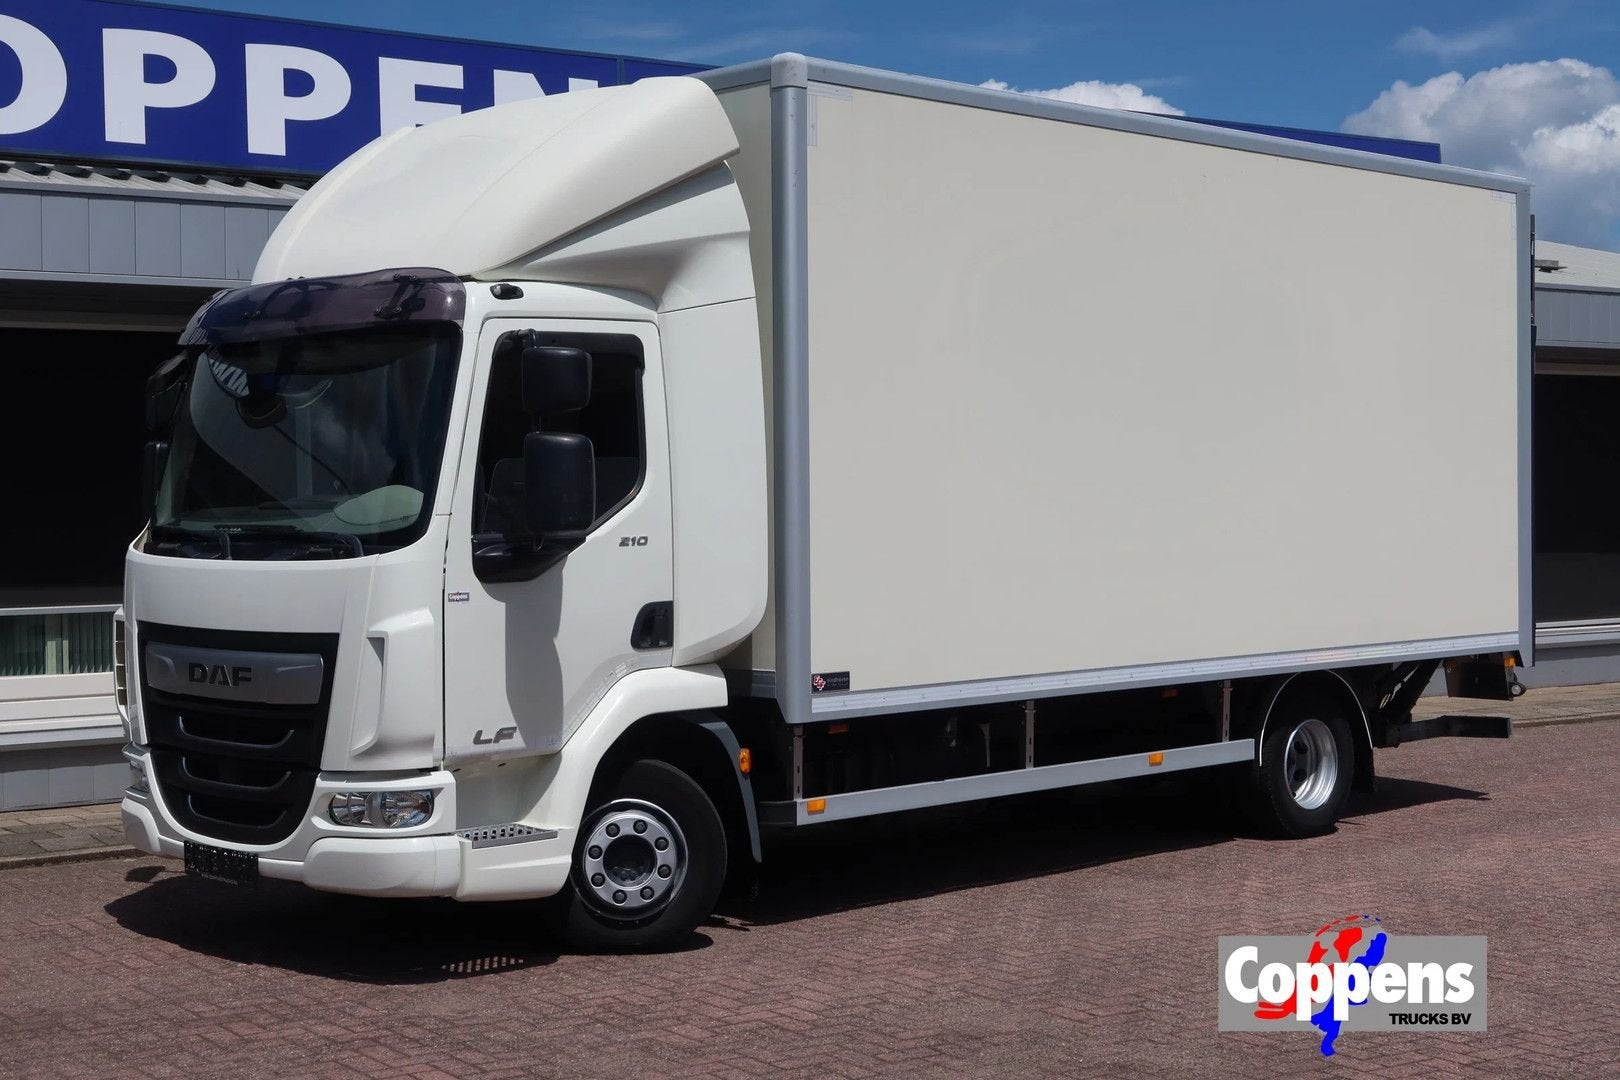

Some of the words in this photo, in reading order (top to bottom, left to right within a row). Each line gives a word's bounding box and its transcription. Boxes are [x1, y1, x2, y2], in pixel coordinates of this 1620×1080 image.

[618, 535, 649, 548] 210
[188, 662, 252, 688] DAF
[472, 726, 518, 746] LF
